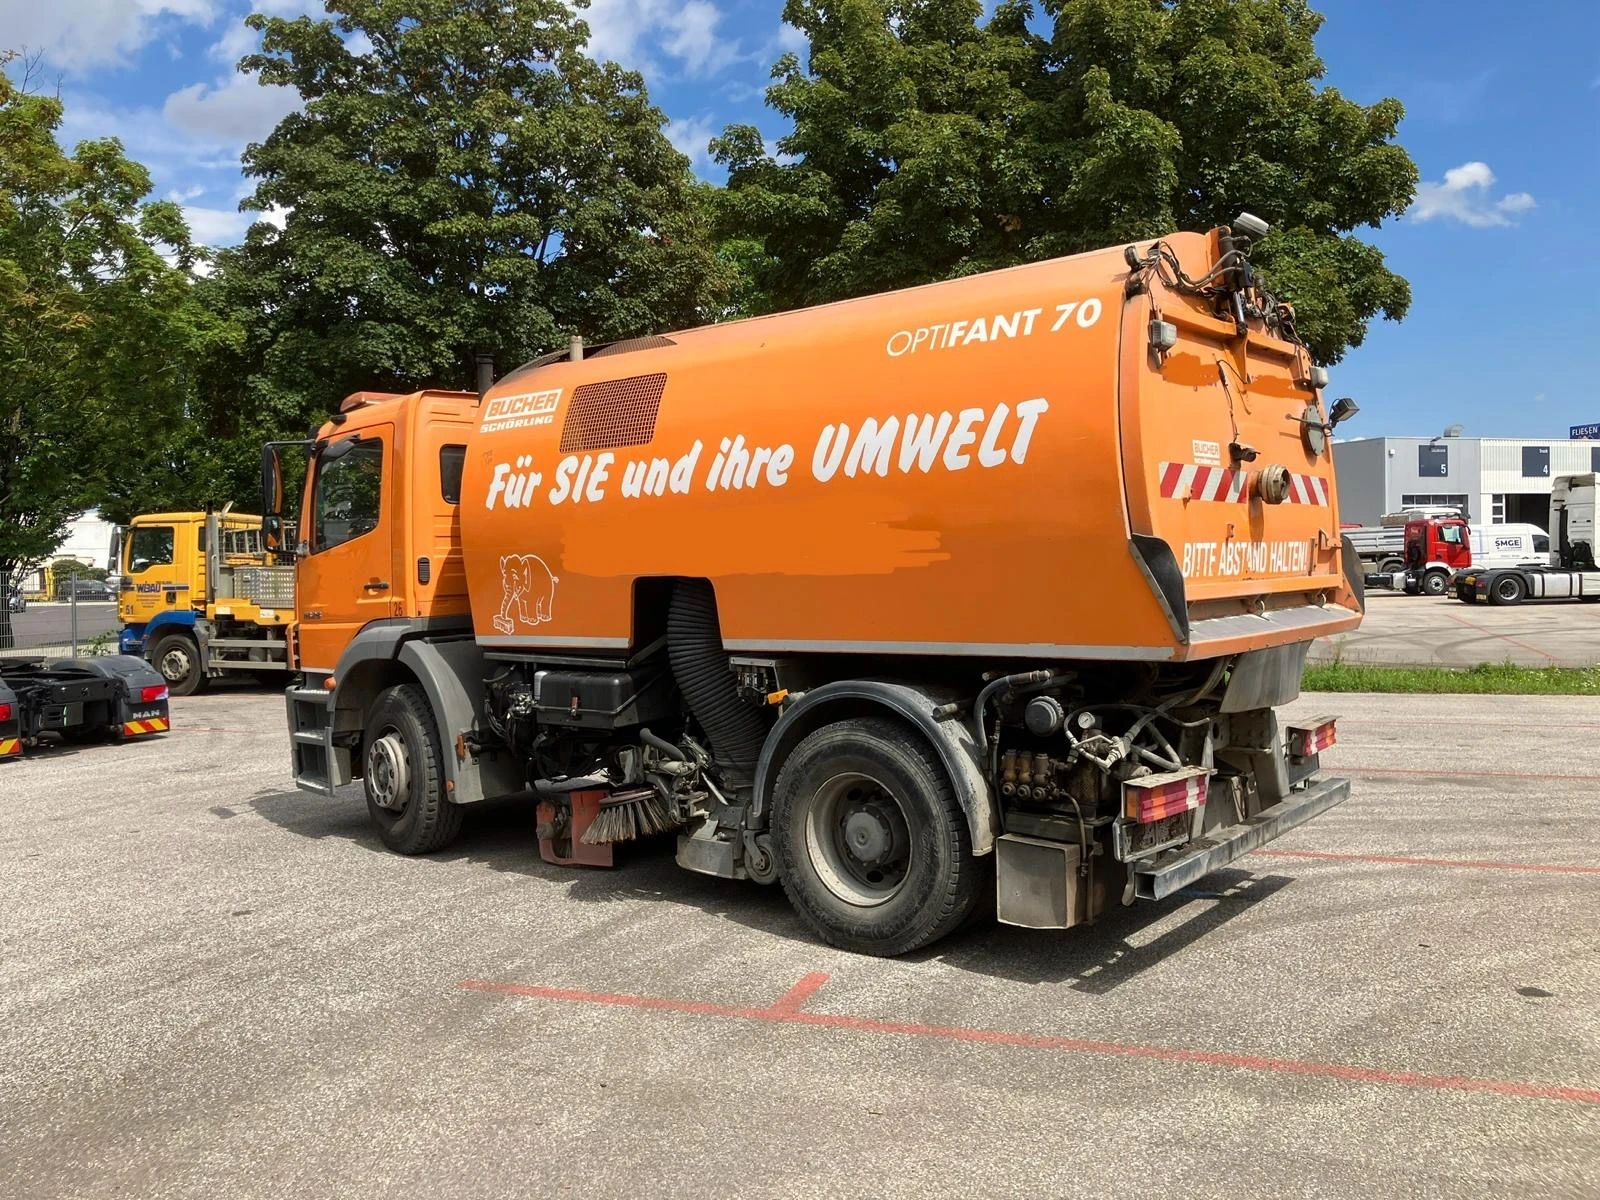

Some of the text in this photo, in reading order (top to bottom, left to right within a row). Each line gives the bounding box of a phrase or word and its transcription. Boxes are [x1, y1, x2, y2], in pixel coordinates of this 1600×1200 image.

[886, 298, 1101, 356] OPTIFANT 70
[489, 391, 558, 418] BUCHER
[480, 415, 553, 433] SCHÖRLING
[1571, 427, 1598, 436] FLIESEN
[486, 398, 1049, 510] Für SIE und ihre UMWELT
[1194, 442, 1219, 456] BUCHER
[1440, 464, 1447, 474] 5
[1543, 465, 1549, 474] 4
[1494, 539, 1520, 547] SMGE
[1219, 542, 1267, 575] ABSTAND
[133, 709, 160, 719] MAN
